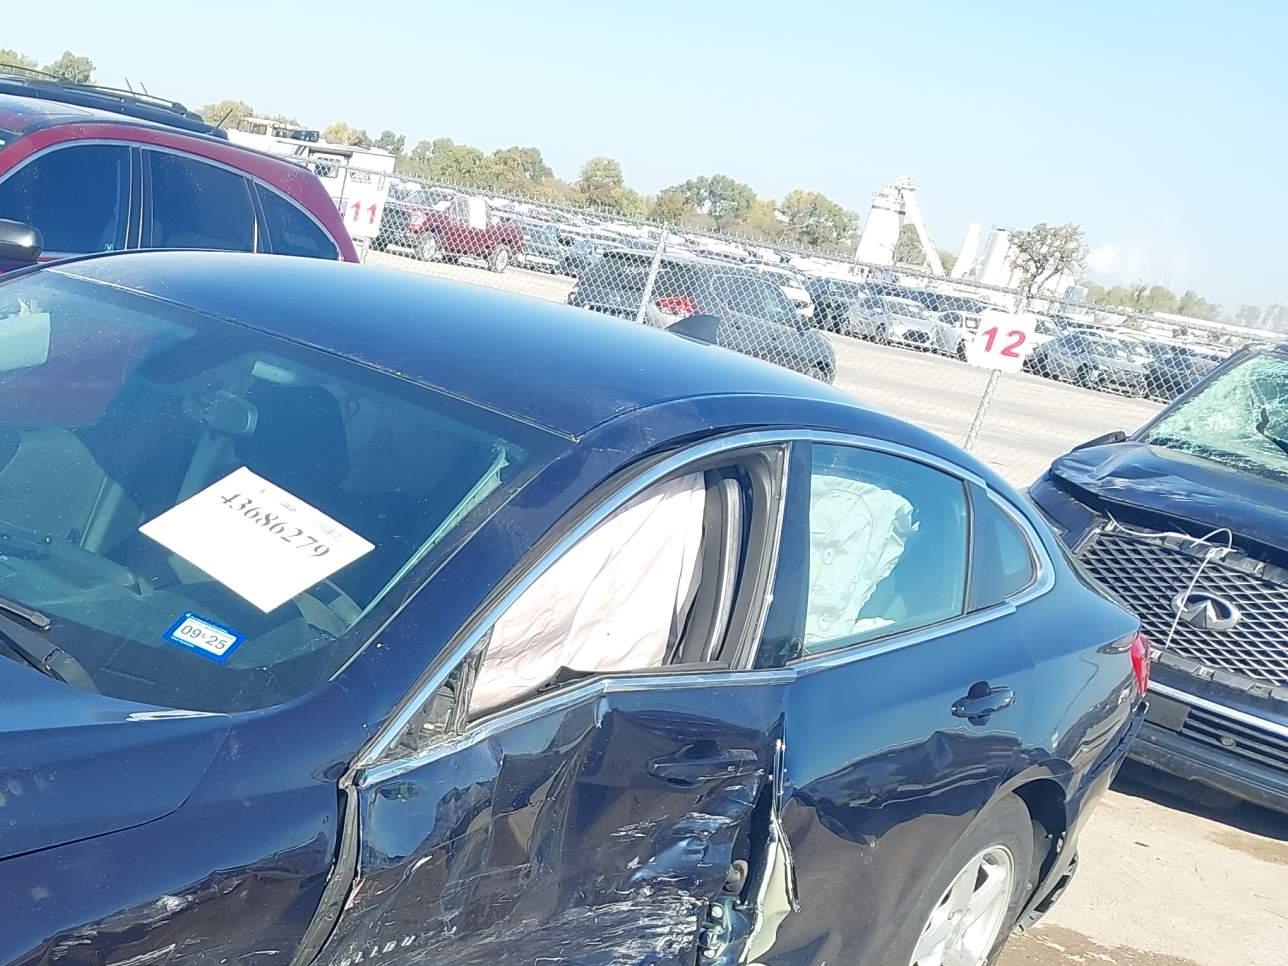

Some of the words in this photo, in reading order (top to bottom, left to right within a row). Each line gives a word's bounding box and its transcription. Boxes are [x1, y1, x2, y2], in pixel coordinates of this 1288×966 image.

[350, 200, 378, 224] 11
[982, 326, 1026, 357] 12
[220, 493, 330, 557] 43686279
[180, 625, 202, 639] 09
[205, 635, 228, 650] 25
